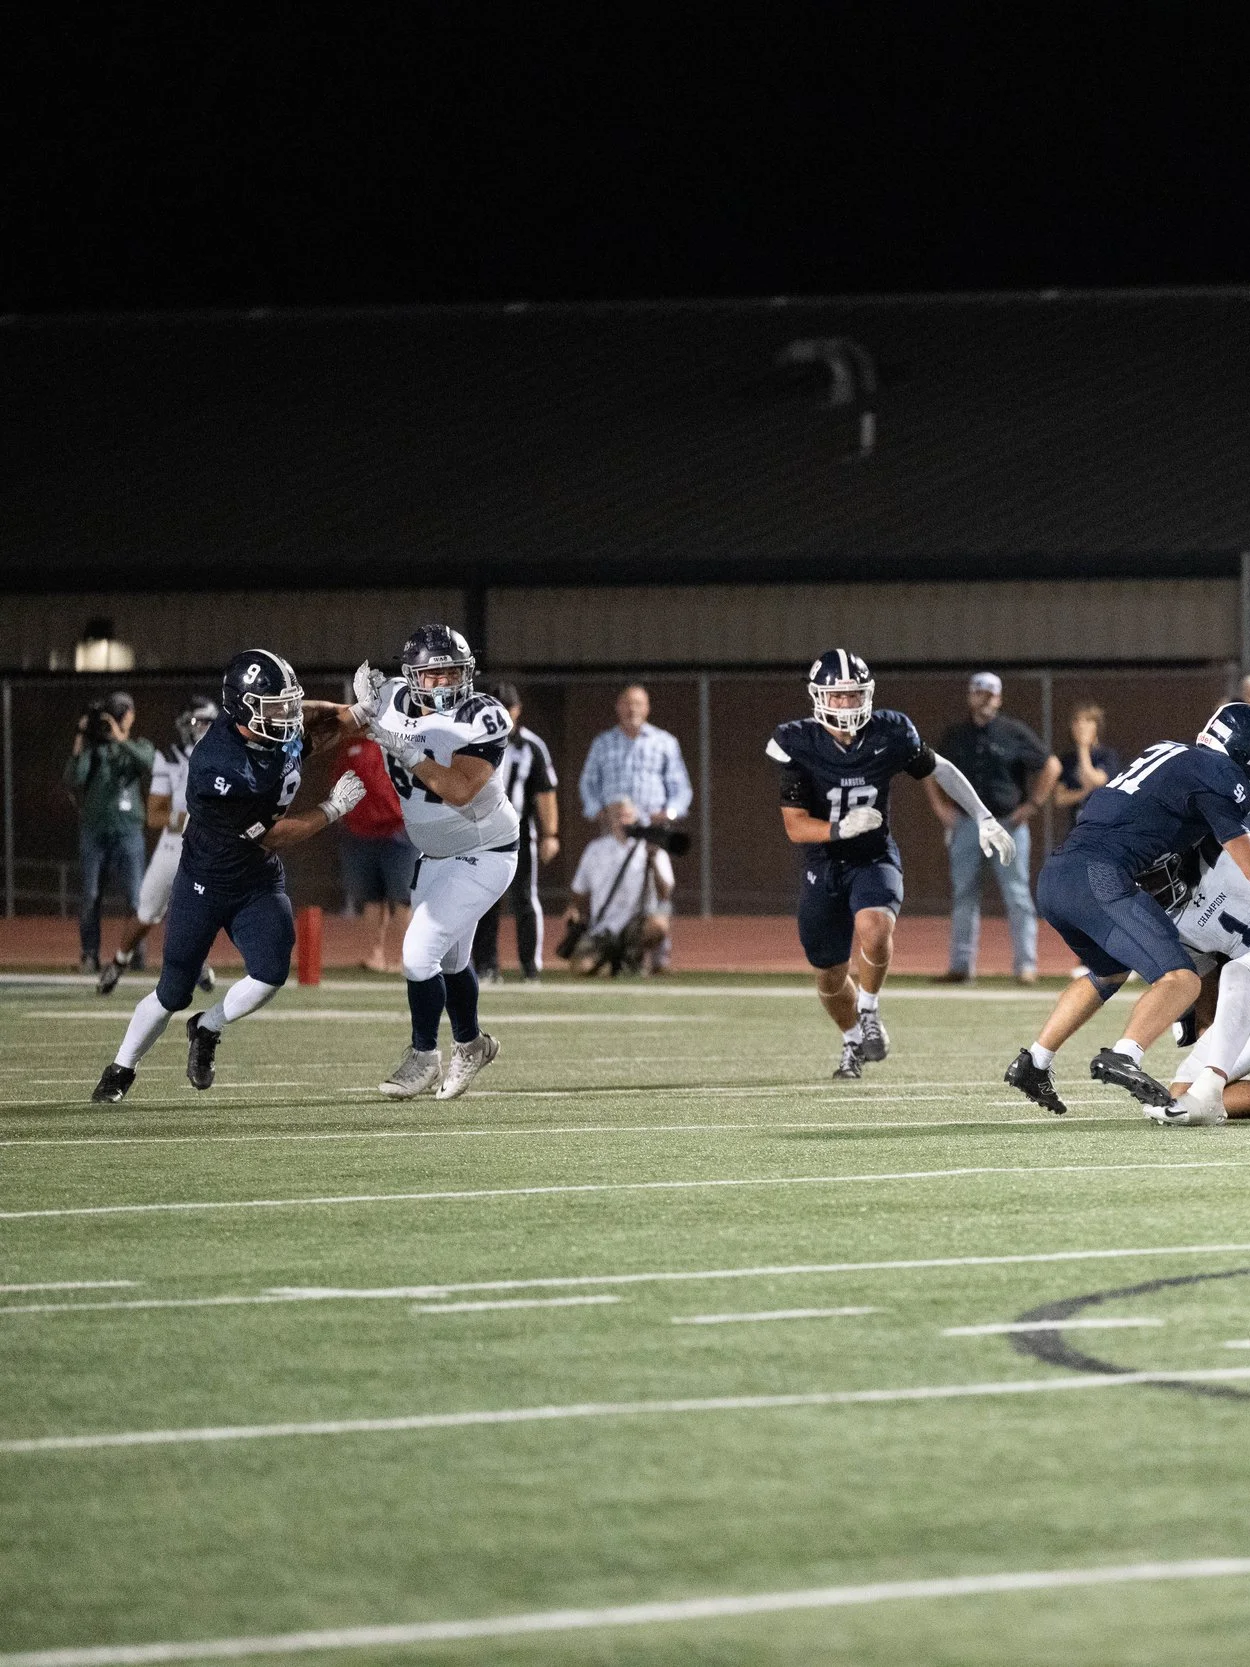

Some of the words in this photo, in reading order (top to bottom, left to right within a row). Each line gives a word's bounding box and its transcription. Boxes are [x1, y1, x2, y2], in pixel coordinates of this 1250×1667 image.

[243, 663, 261, 684] 9
[482, 709, 507, 735] 64
[392, 731, 427, 743] HAMPION
[1105, 740, 1190, 795] 31
[214, 776, 232, 796] SV
[1233, 783, 1246, 804] SV
[1197, 892, 1228, 928] CHAMPION
